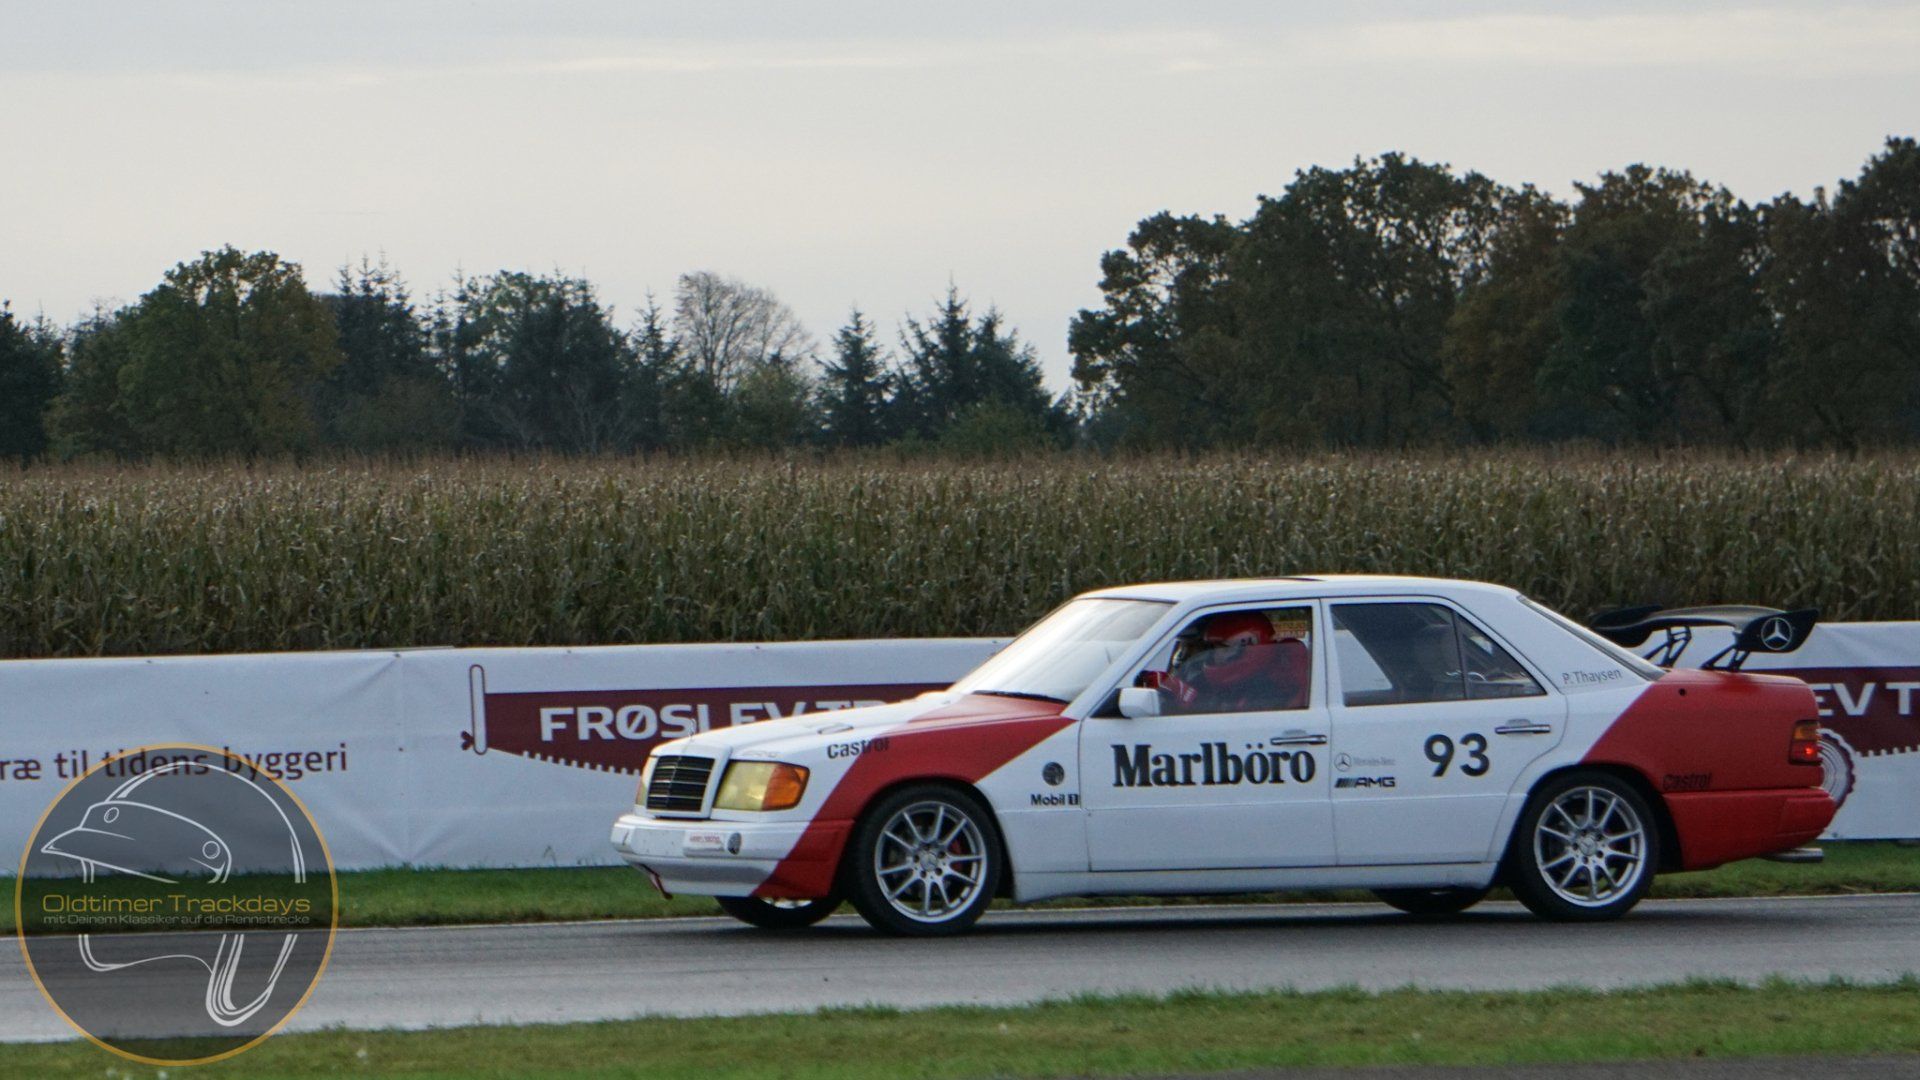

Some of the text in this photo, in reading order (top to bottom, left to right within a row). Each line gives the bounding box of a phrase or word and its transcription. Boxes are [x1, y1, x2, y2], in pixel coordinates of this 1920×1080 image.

[54, 750, 88, 778] til
[102, 748, 209, 778] tidens
[224, 743, 346, 782] byggeri
[827, 737, 890, 759] Castrol
[1111, 742, 1315, 787] Marlböro
[1424, 733, 1490, 777] 93
[1031, 794, 1066, 805] Mobil
